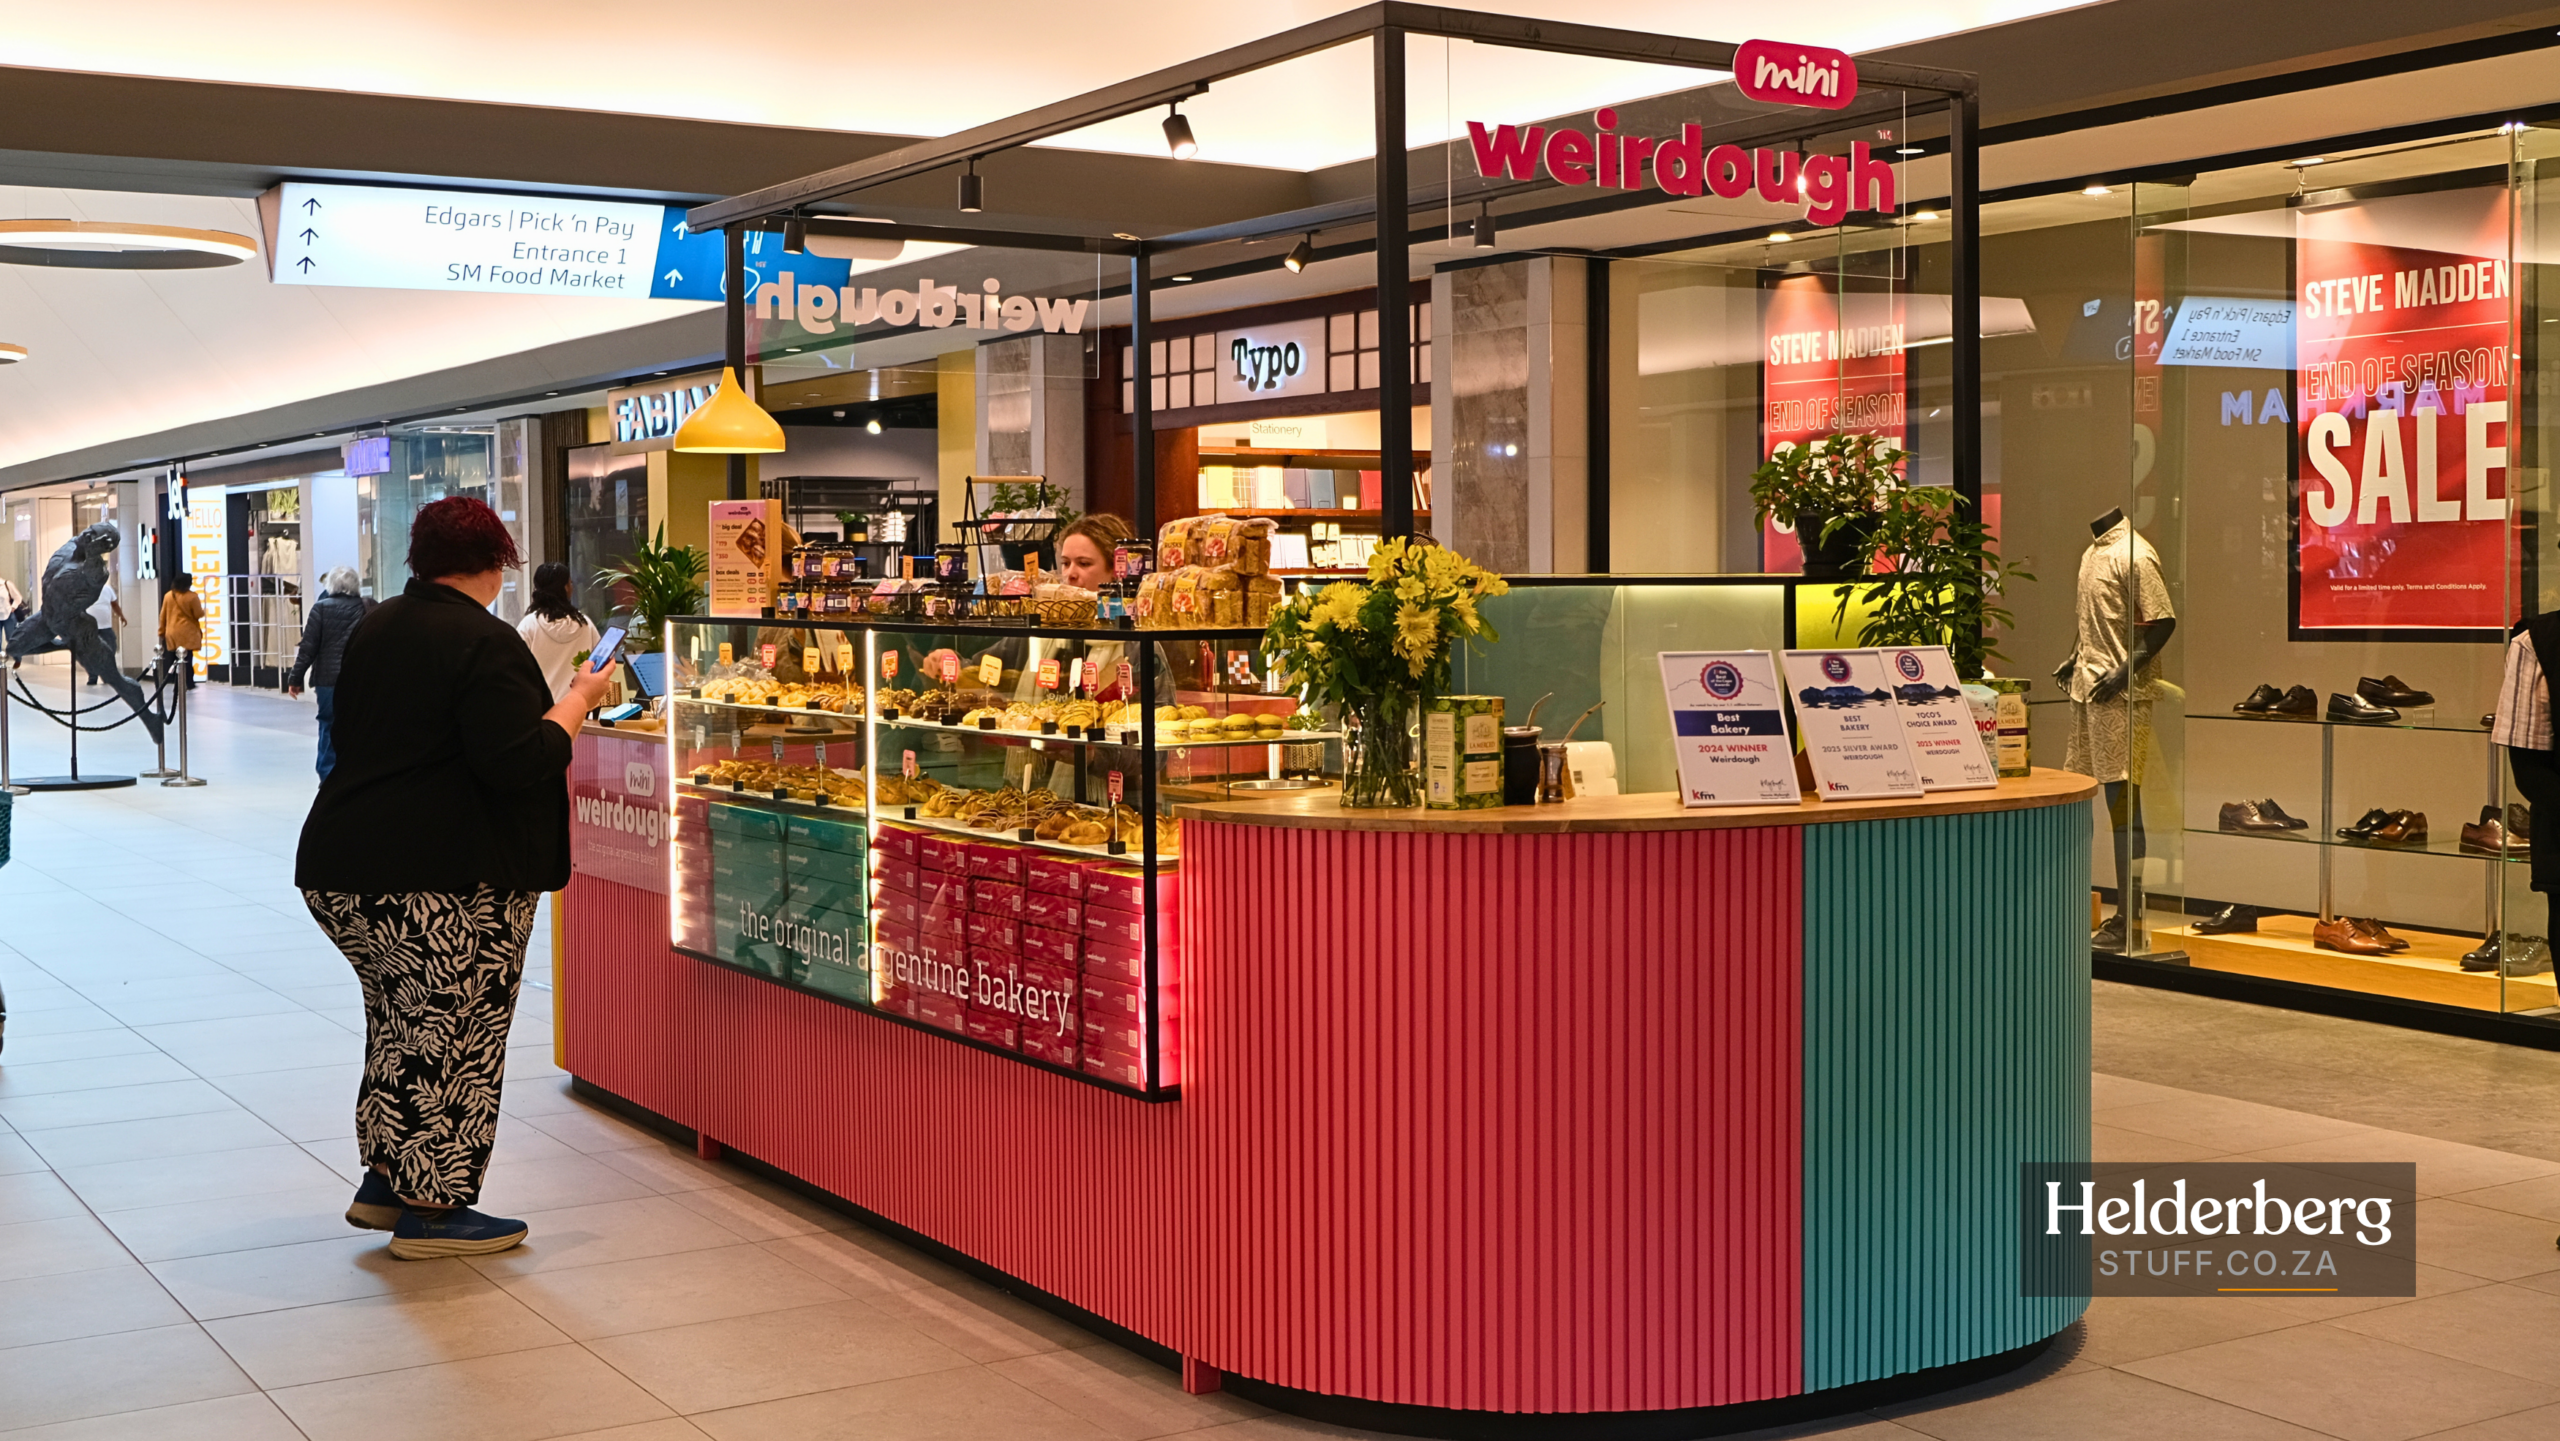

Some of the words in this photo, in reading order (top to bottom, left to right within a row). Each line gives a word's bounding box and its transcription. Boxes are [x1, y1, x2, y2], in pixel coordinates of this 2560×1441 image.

[1754, 55, 1840, 97] mini
[1466, 107, 1895, 227] weirdough
[425, 205, 501, 231] Edgars
[519, 211, 564, 232] Pick
[595, 216, 635, 241] Pay
[512, 241, 609, 264] Entrance
[617, 248, 627, 265] 1
[446, 263, 482, 283] SM
[490, 265, 543, 285] Food
[550, 268, 625, 289] Market
[2305, 273, 2384, 319] STEVE
[2395, 258, 2510, 309] MADDEN
[1770, 331, 1822, 366] STEVE
[1828, 324, 1904, 361] MADDEN
[1231, 337, 1300, 392] Typo
[2305, 360, 2356, 402] END
[2362, 357, 2396, 398] OF
[2401, 346, 2511, 394] SEASON
[616, 384, 717, 443] FABIA
[1769, 400, 1802, 432] END
[1806, 398, 1828, 431] OF
[1831, 393, 1904, 430] SEASON
[1251, 422, 1302, 438] Stationery
[2306, 400, 2512, 528] SALE
[167, 468, 187, 520] Jet
[186, 508, 222, 529] HELLO
[137, 523, 157, 580] Jet
[1717, 713, 1740, 722] Best
[1906, 720, 1931, 728] CHOICE
[1932, 719, 1957, 727] AWARD
[1916, 711, 1941, 719] YOCO'S
[1710, 725, 1750, 736] Bakery
[1839, 723, 1870, 732] BAKERY
[1698, 744, 1724, 753] 2024
[1726, 744, 1768, 752] WINNER
[1822, 745, 1841, 753] 2025
[1843, 744, 1868, 752] SILVER
[1870, 743, 1898, 752] AWARD
[1933, 738, 1961, 747] WINNER
[1709, 755, 1760, 765] Weirdough
[1842, 753, 1884, 761] WEIRDOUGH
[629, 769, 651, 791] mini
[1828, 781, 1849, 791] kfm
[1921, 776, 1934, 785] fm
[1692, 789, 1716, 800] kfm
[576, 787, 671, 848] weirdough
[740, 900, 769, 942] the
[775, 919, 850, 966] original
[977, 962, 1070, 1037] bakery
